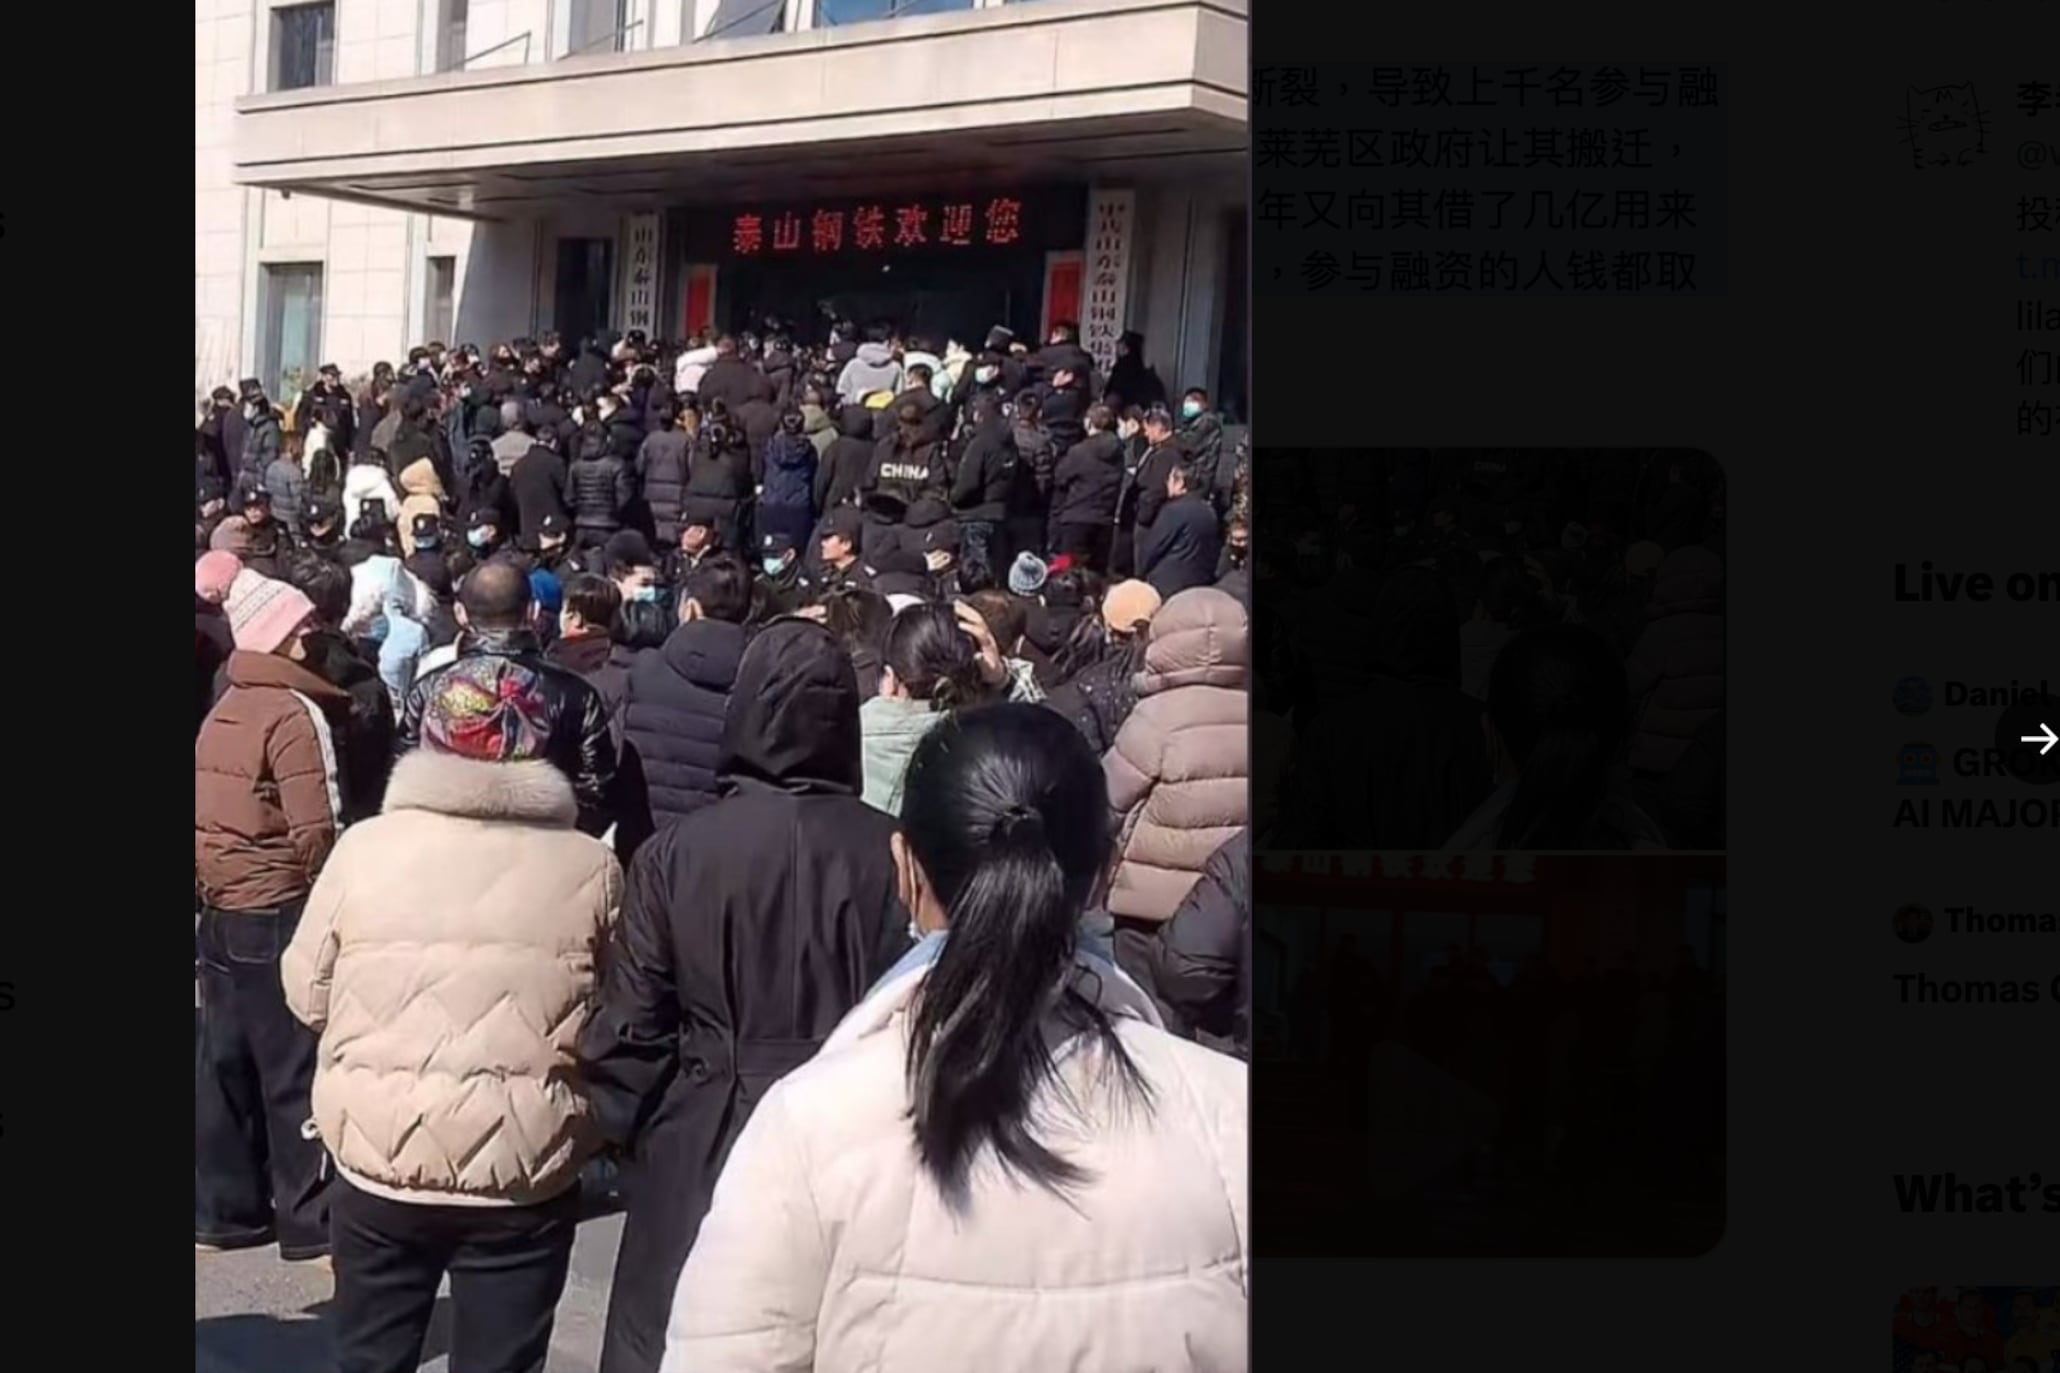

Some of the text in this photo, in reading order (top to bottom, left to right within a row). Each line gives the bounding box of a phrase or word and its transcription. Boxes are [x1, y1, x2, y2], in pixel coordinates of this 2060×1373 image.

[2016, 80, 2060, 117] 李
[733, 197, 1022, 254] 泰山钢铁欢迎您
[1257, 187, 1697, 232] 年又向其借了几亿用来
[2016, 195, 2060, 232] 投
[2016, 348, 2060, 386] 们
[2017, 399, 2060, 437] 的
[880, 461, 930, 480] CHINA
[1895, 561, 1994, 602] Live
[1944, 679, 2049, 706] Daniel
[1892, 798, 1929, 828] AI
[1943, 905, 2060, 933] Thoma
[1892, 972, 2040, 1003] Thomas
